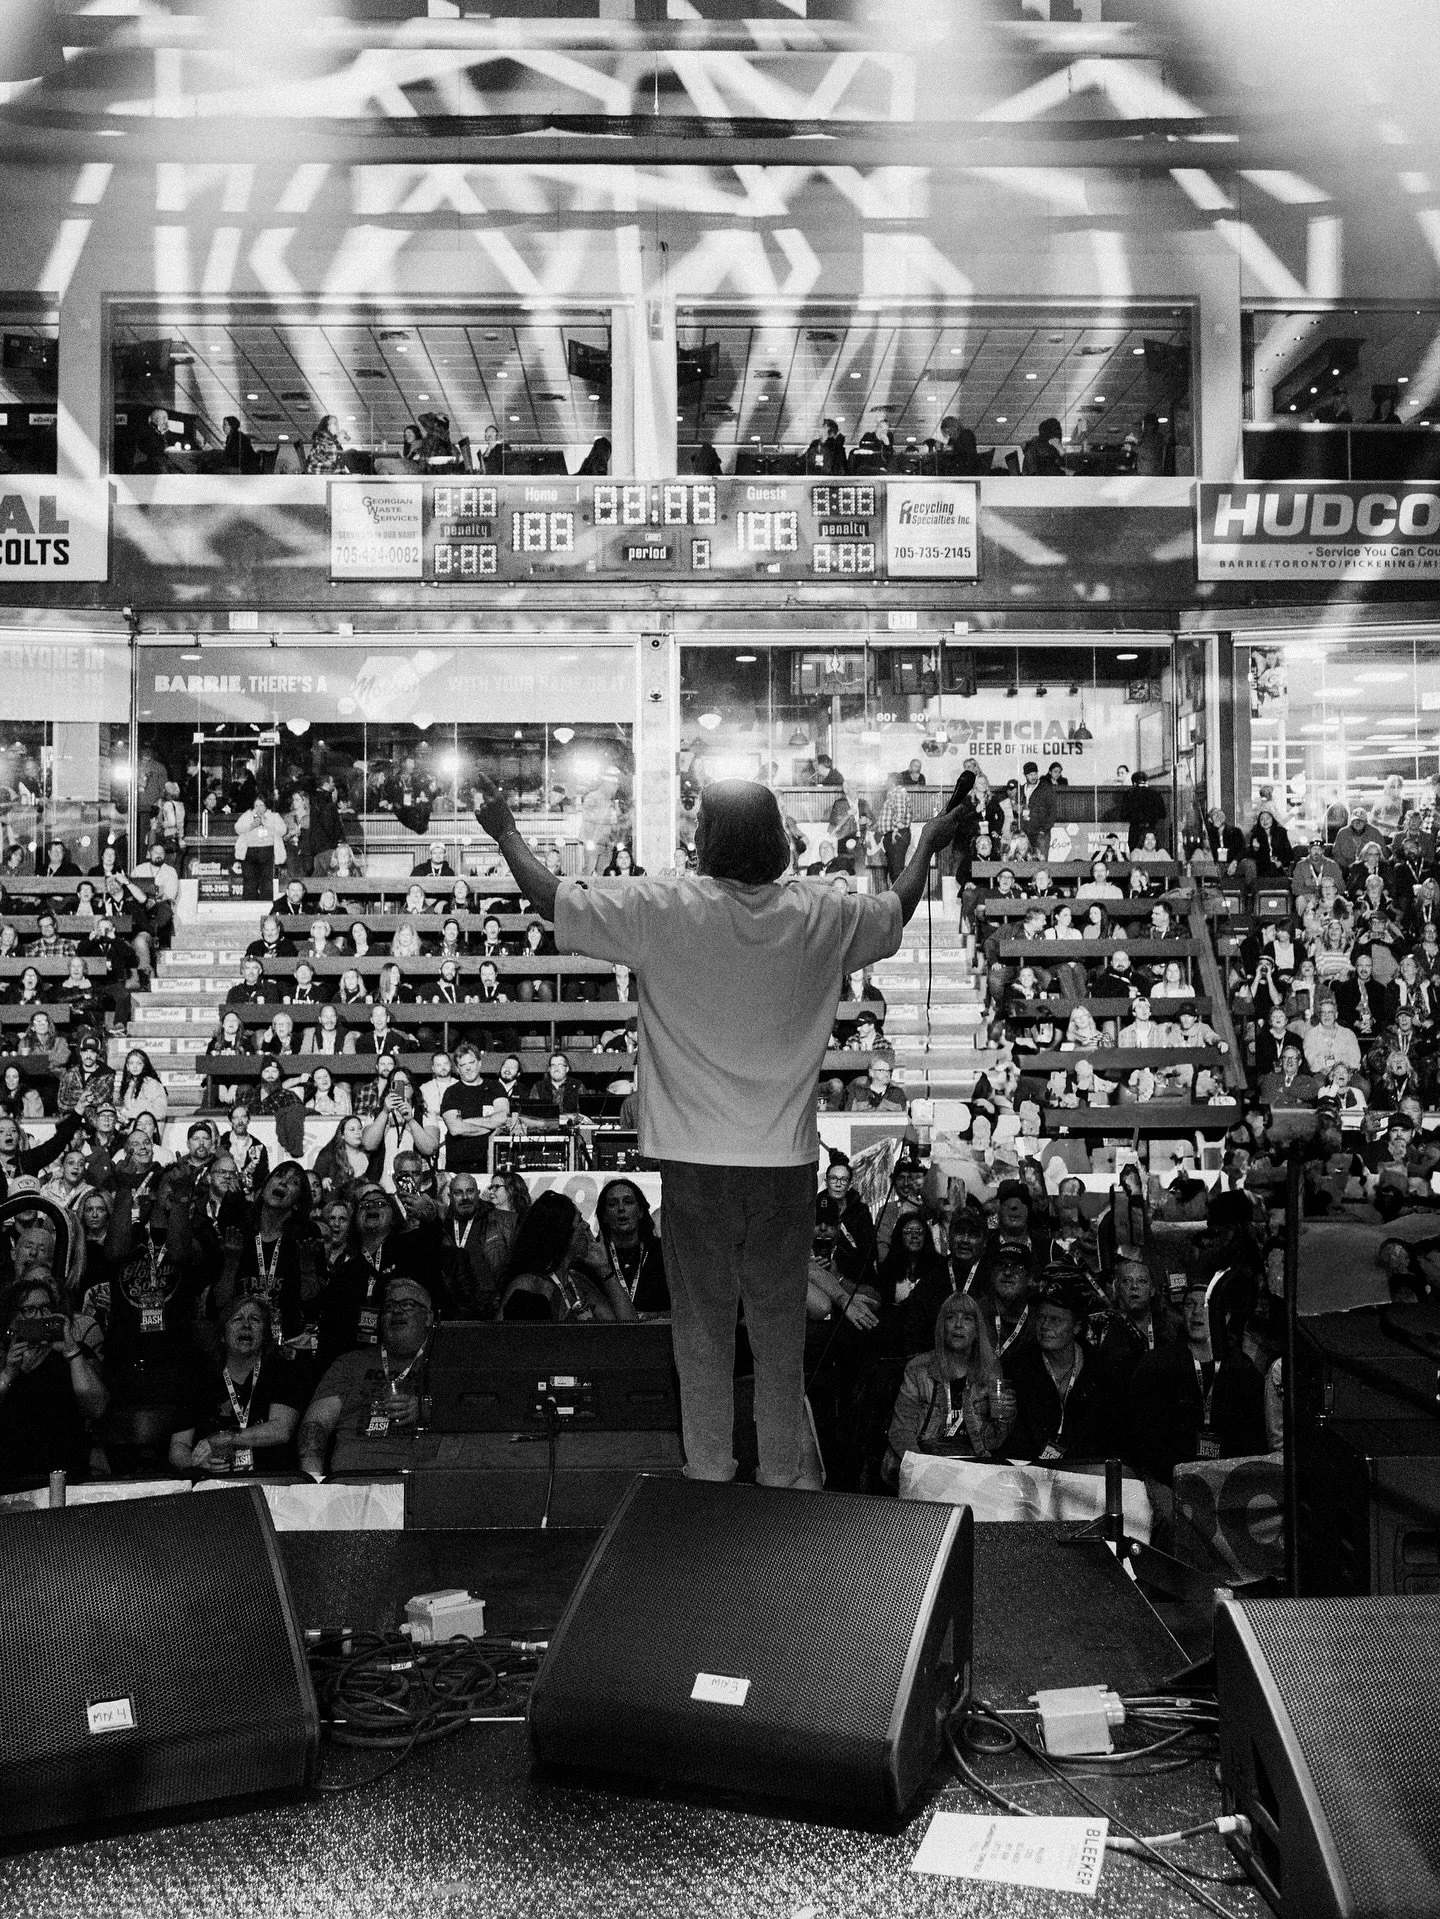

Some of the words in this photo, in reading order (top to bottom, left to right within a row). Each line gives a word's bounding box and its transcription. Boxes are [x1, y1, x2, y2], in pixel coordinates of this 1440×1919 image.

[525, 486, 558, 501] Home
[747, 487, 787, 500] Guests
[362, 496, 413, 507] GEORGIAN
[0, 495, 70, 534] AL
[367, 505, 402, 515] WASTE
[899, 500, 955, 525] Recycling
[1213, 493, 1440, 537] HUDCO
[373, 515, 419, 524] SERVICES
[912, 515, 956, 526] Specialties
[957, 515, 972, 524] Inc.
[442, 524, 488, 537] penalty
[822, 522, 866, 536] penalty
[0, 539, 70, 566] OLTS
[628, 546, 667, 561] period
[894, 546, 972, 559] 705-735-2145
[1316, 546, 1361, 557] Service
[1364, 546, 1386, 556] You
[1391, 546, 1414, 557] Can
[155, 675, 246, 694] BARRIE,
[248, 676, 312, 693] THERE'S
[316, 676, 328, 693] A
[970, 742, 1002, 755] BEER
[1005, 744, 1016, 754] OF
[1021, 744, 1039, 754] THE
[1043, 742, 1084, 755] COLTS
[142, 1316, 162, 1325] BASH
[369, 1422, 389, 1431] BASH
[729, 1680, 739, 1694] 3
[93, 1711, 113, 1723] MIX
[117, 1707, 127, 1720] 4
[1073, 1827, 1102, 1888] BLEEKER
